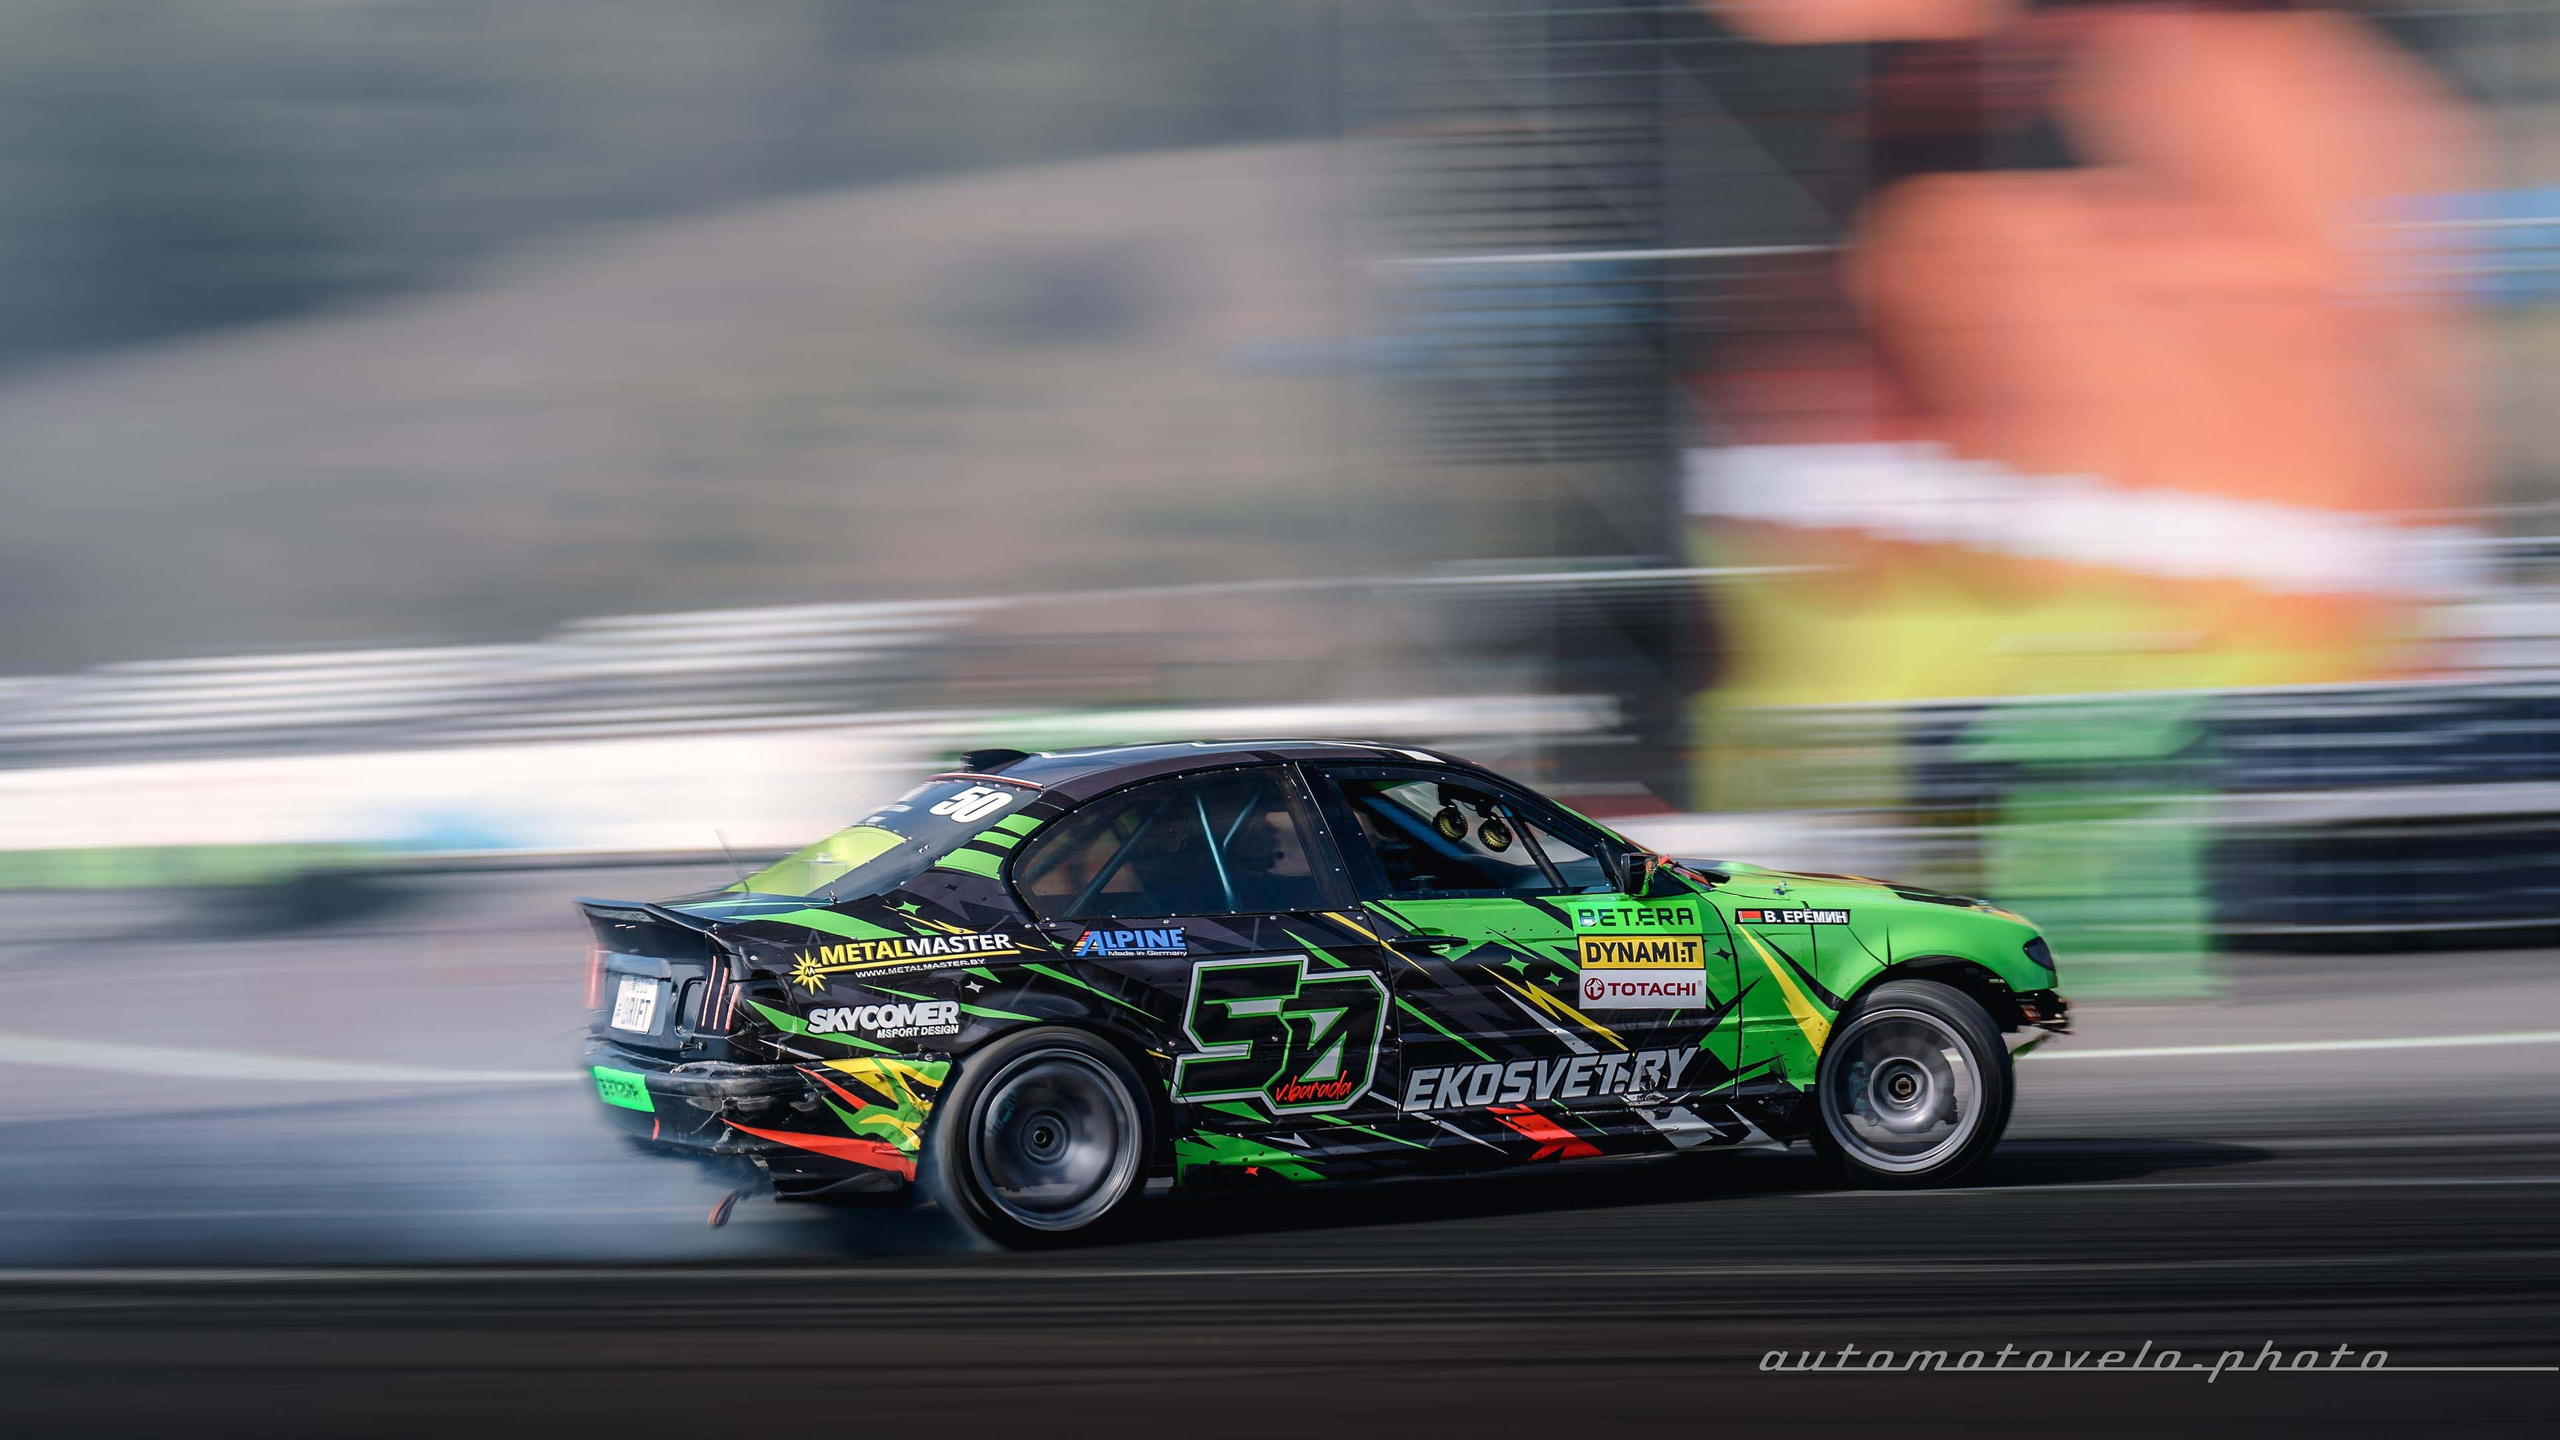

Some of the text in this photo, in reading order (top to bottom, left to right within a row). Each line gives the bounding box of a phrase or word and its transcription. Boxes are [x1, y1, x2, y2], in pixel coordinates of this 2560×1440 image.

[929, 786, 1013, 823] 50
[1783, 908, 1848, 923] ЕРЁМИН
[819, 933, 1015, 966] METALMASTER
[1074, 928, 1187, 957] ALPINE
[1607, 982, 1696, 996] TOTACHI
[807, 1001, 960, 1034] SKYCOMER
[876, 1025, 960, 1039] MSPORT DESIGN
[1170, 955, 1390, 1116] 50
[1402, 1046, 1699, 1112] EKOSVET.BY
